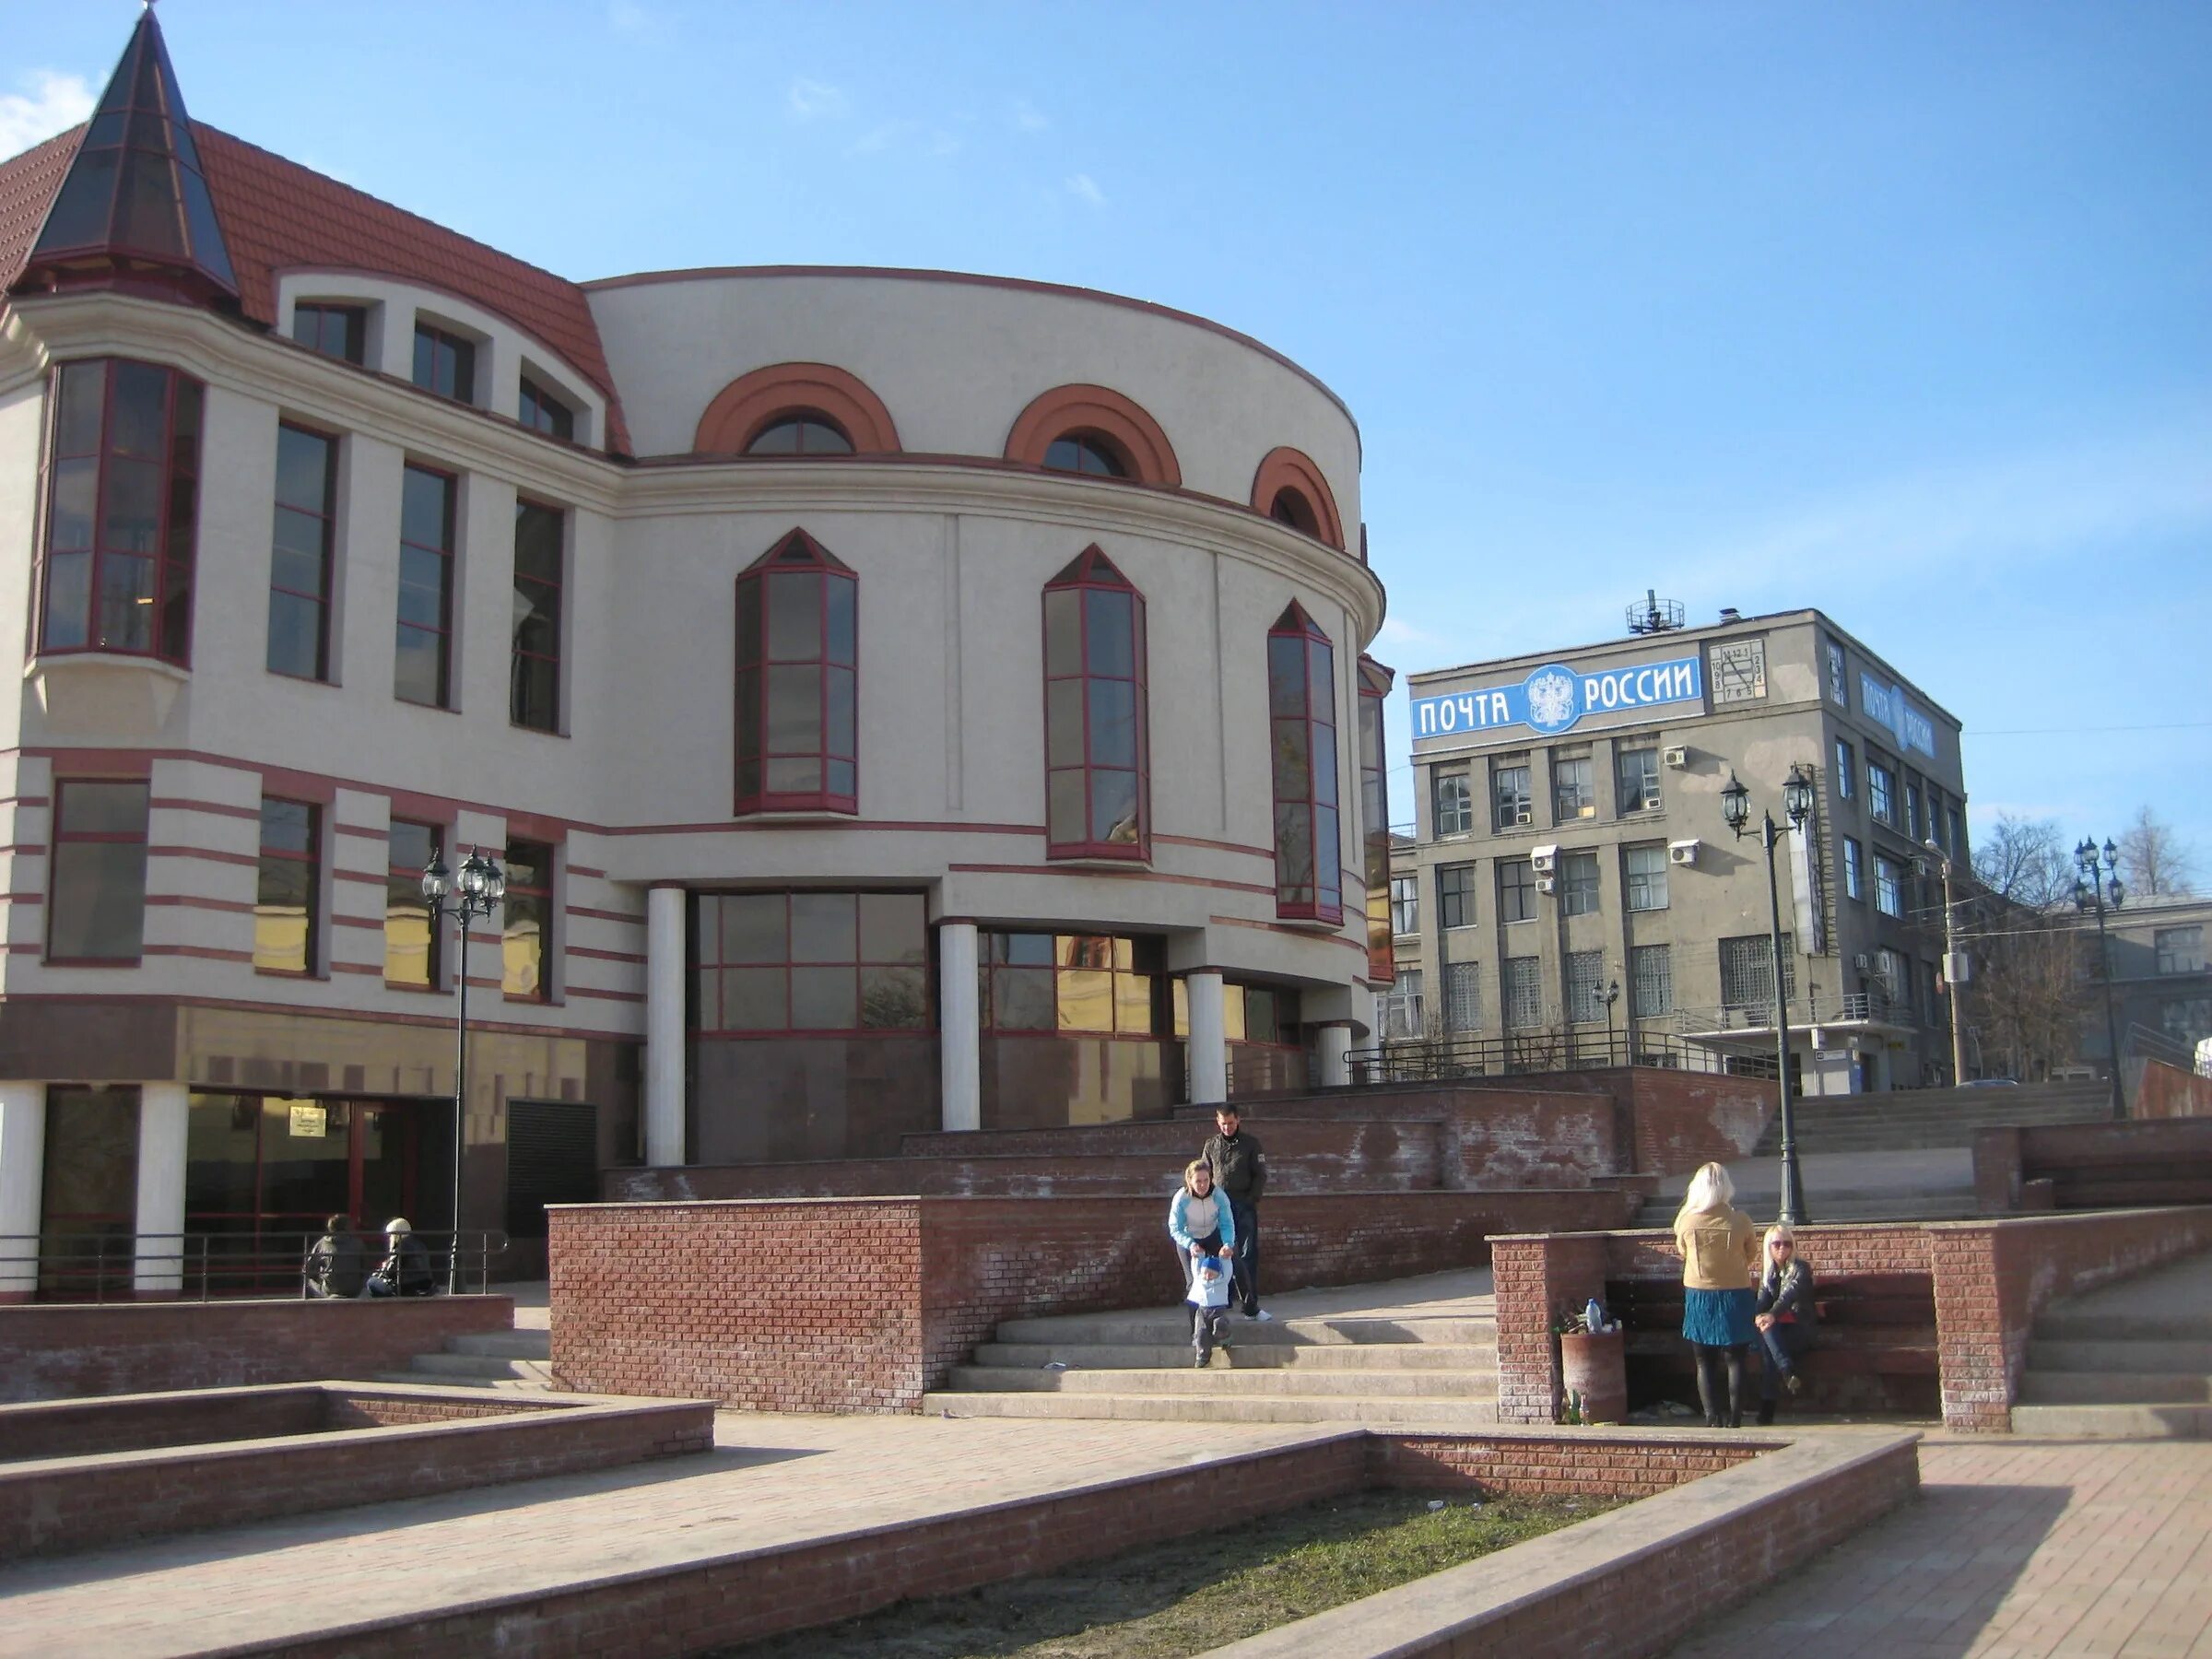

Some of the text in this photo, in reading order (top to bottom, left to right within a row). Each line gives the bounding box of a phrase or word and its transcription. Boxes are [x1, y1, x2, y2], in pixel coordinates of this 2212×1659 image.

[1733, 649, 1742, 658] 12
[1755, 656, 1759, 665] 2
[1712, 663, 1721, 671] 10
[1756, 665, 1760, 674] 3
[1714, 671, 1720, 680] 9
[1757, 675, 1762, 684] 4
[1715, 681, 1720, 689] 8
[1726, 687, 1752, 699] 7 6 5
[1420, 663, 1692, 734] ПОЧТА РОССИИ
[1864, 681, 1889, 723] ПОЧТА
